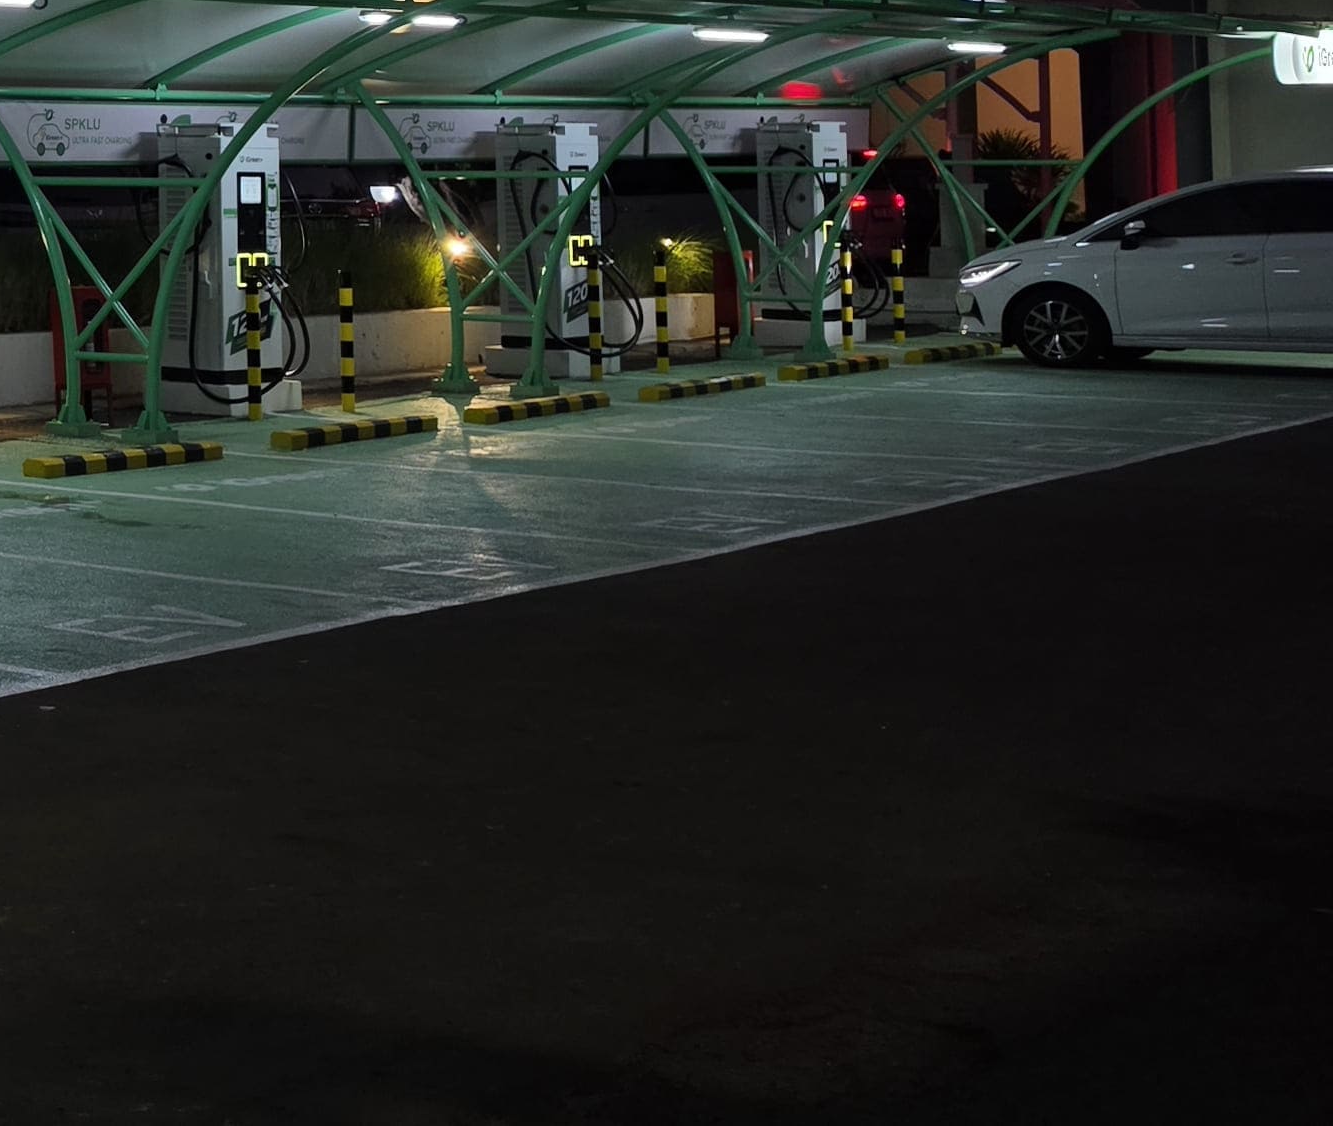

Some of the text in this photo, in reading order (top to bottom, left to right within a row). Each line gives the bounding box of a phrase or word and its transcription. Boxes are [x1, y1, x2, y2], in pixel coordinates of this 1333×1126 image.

[64, 118, 101, 130] SPKLU
[427, 121, 455, 132] SPKLU
[567, 282, 588, 307] 120
[45, 604, 247, 644] EV
